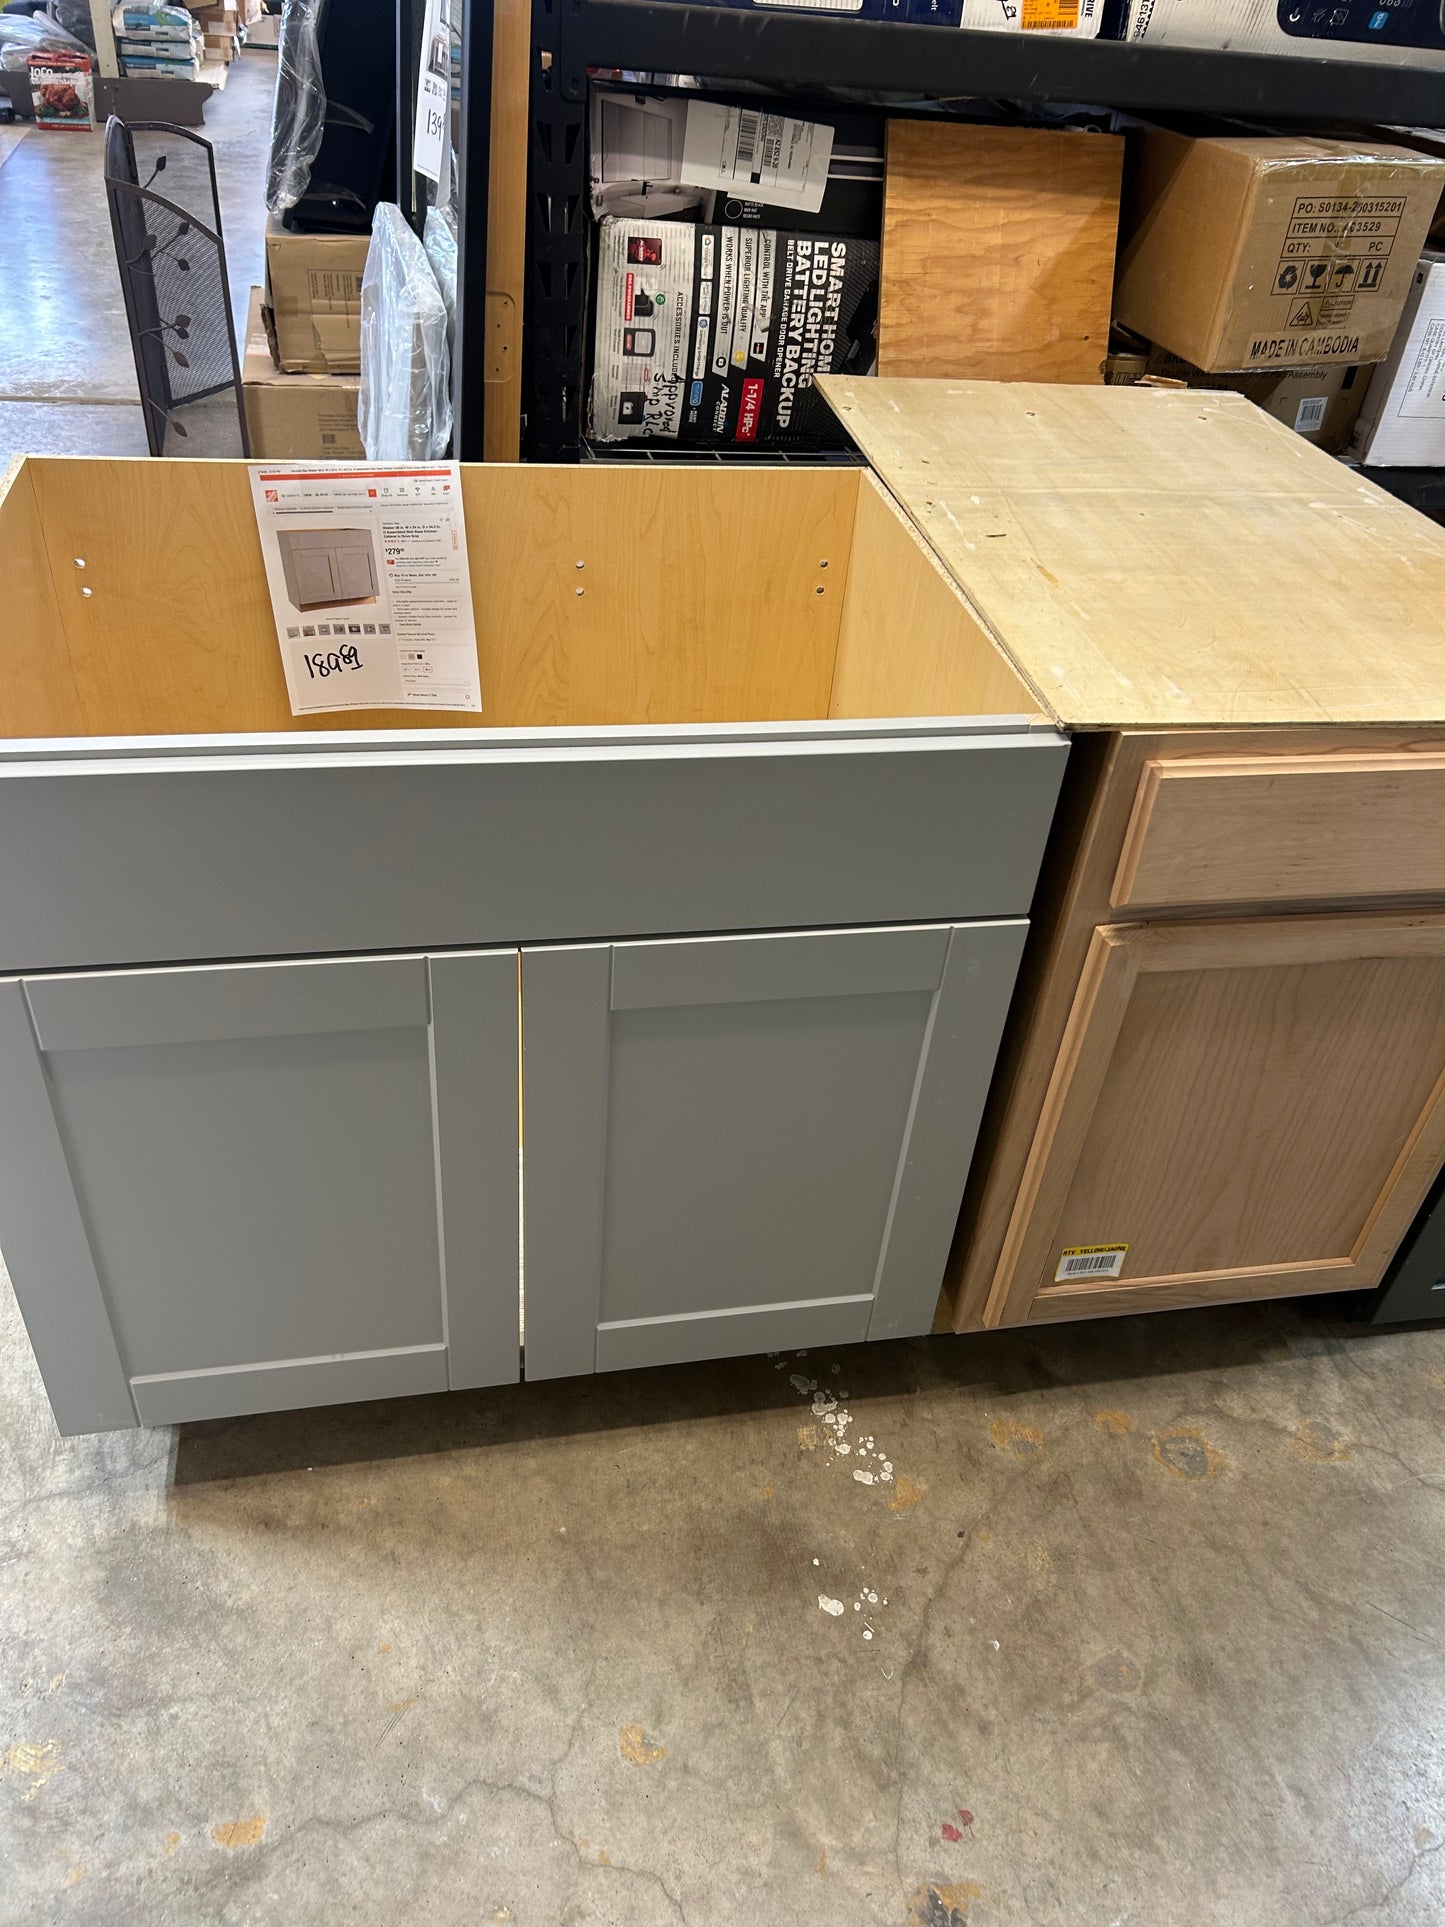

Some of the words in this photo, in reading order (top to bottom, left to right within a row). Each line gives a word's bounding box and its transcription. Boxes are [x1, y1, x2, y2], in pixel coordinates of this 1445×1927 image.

[1297, 202, 1316, 214] PO:
[1292, 222, 1317, 234] ITEM
[725, 236, 734, 262] WORKS
[744, 238, 752, 272] SUPERIOR
[762, 239, 771, 270] CONTROL
[787, 240, 795, 260] BELT
[1286, 244, 1312, 254] QTY:
[1368, 241, 1384, 252] PC
[723, 264, 732, 285] WHEN
[784, 262, 793, 289] DRIVE
[812, 241, 830, 285] LED
[740, 273, 751, 304] LIGHTING
[760, 271, 769, 289] WITH
[788, 240, 812, 342] BATTERY
[828, 242, 846, 321] SMART
[722, 286, 731, 312] POWER
[760, 290, 768, 304] THE
[674, 291, 684, 344] ACCESSORIES
[738, 306, 749, 332] QUALITY
[759, 304, 767, 318] APP
[720, 321, 729, 334] OUT
[779, 324, 788, 346] DOOR
[798, 288, 826, 390] LIGHTING
[817, 324, 838, 375] HOM
[1249, 338, 1286, 360] MADE
[1284, 339, 1299, 358] IN
[774, 347, 786, 378] OPENER
[776, 345, 800, 428] BACKUP
[1288, 370, 1328, 382] Assembly
[716, 384, 731, 434] ALADDIN
[746, 383, 759, 411] 1-1/4
[712, 401, 721, 432] CONNECT
